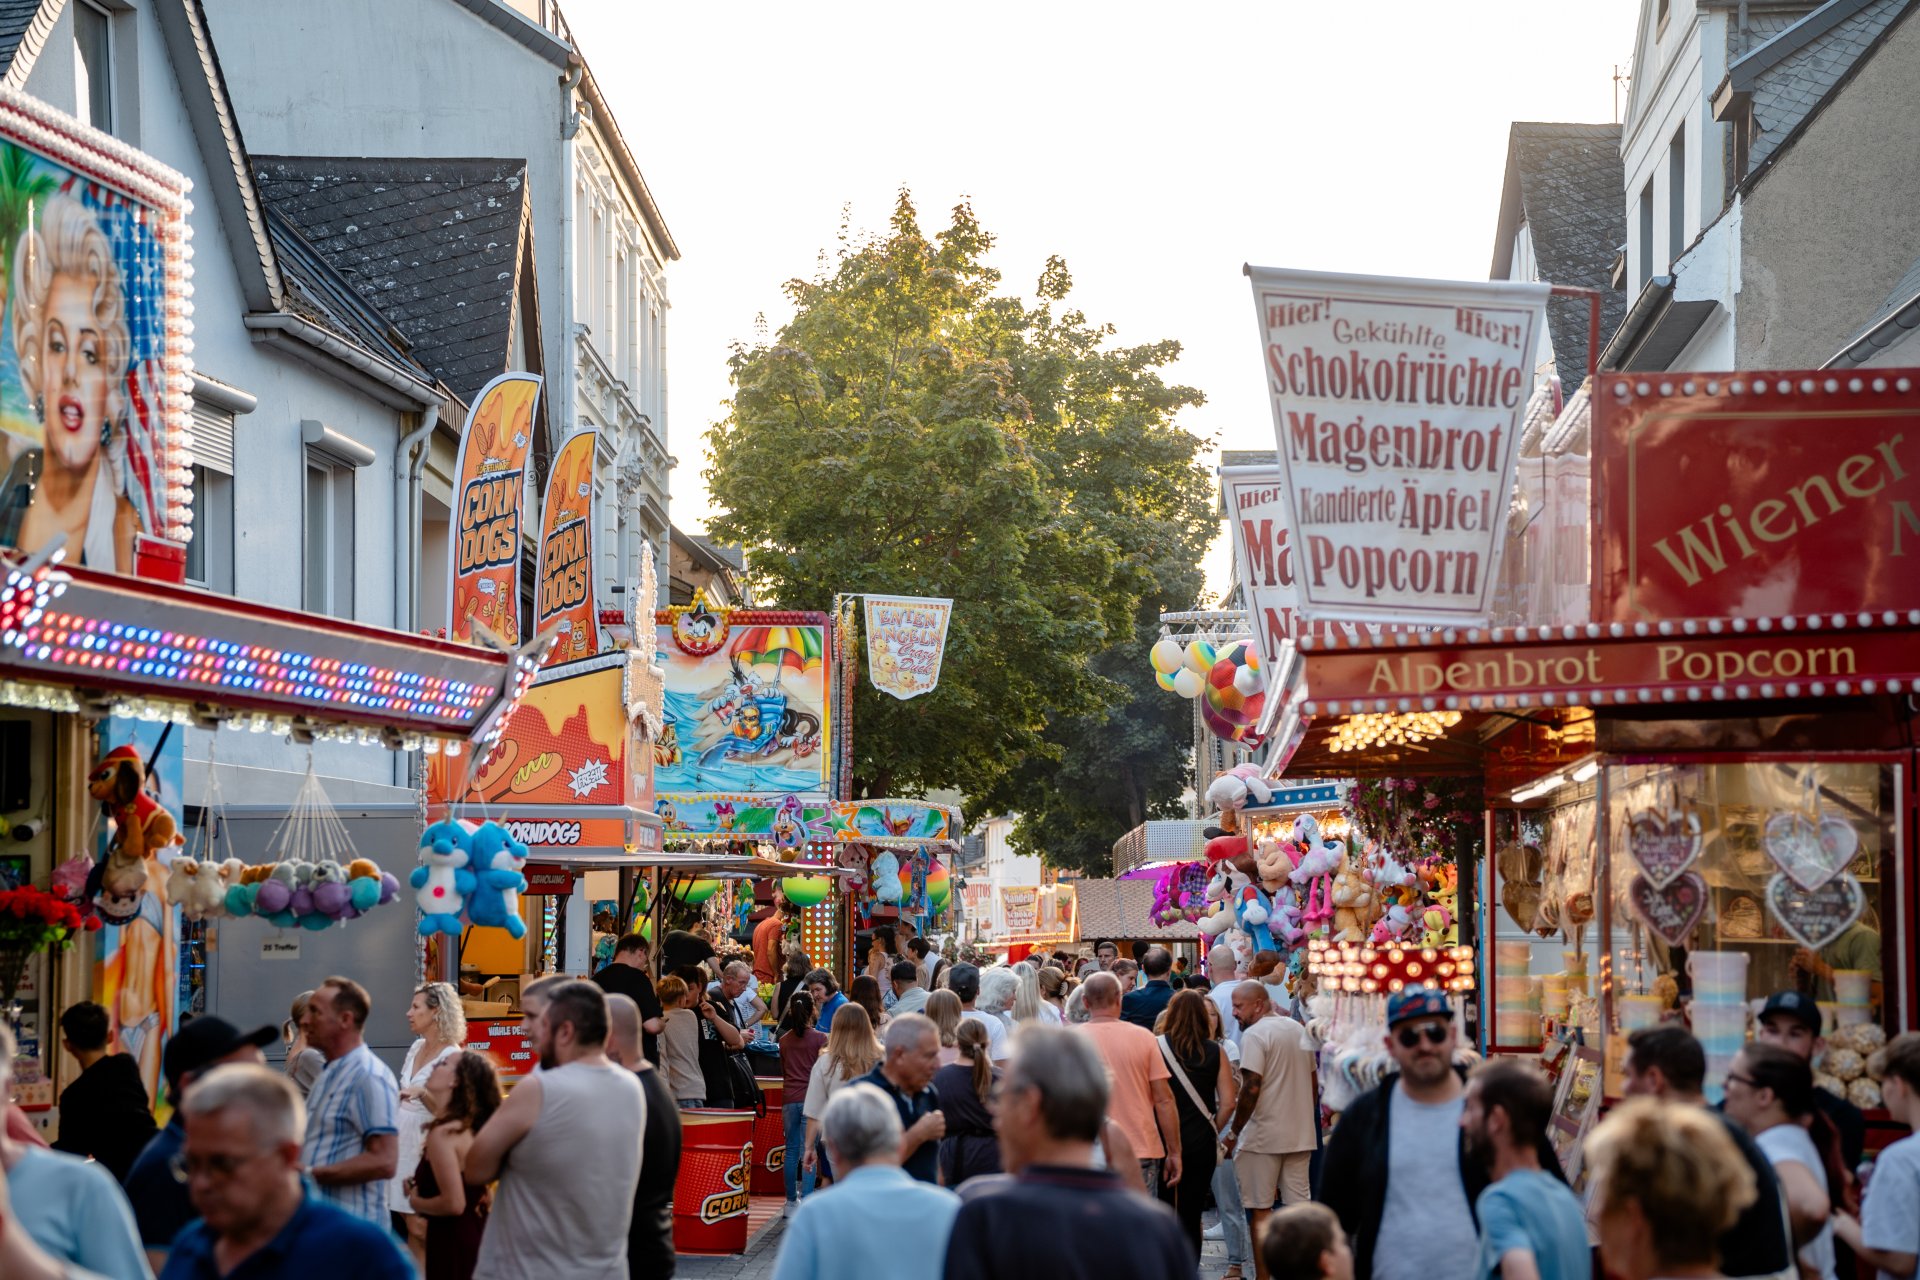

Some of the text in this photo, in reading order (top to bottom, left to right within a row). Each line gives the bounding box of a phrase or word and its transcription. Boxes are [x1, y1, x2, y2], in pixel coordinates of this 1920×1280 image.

[1269, 297, 1331, 329] Hier!
[1455, 308, 1521, 349] Hier!
[1333, 317, 1446, 350] Gekühlte
[1267, 343, 1522, 409] Schokofrüchte
[1287, 410, 1503, 473] Magenbrot
[462, 474, 521, 530] CORN
[1239, 487, 1281, 510] Hier
[1300, 478, 1490, 535] Kandierte Äpfel
[1653, 432, 1909, 588] Wiener
[461, 513, 516, 570] DOGS
[544, 523, 586, 580] CORN
[1306, 534, 1480, 598] Popcorn
[541, 557, 588, 616] DOGS
[871, 626, 942, 647] ANGELN
[879, 609, 937, 629] ENTEN
[898, 642, 938, 665] Crazy
[899, 657, 935, 675] Duck
[1368, 645, 1856, 697] Alpenbrot Popcorn
[576, 766, 602, 790] FRESH
[531, 874, 565, 885] ABHOLUNG
[488, 1022, 511, 1037] WÄHLE
[511, 1052, 531, 1060] CHEESE
